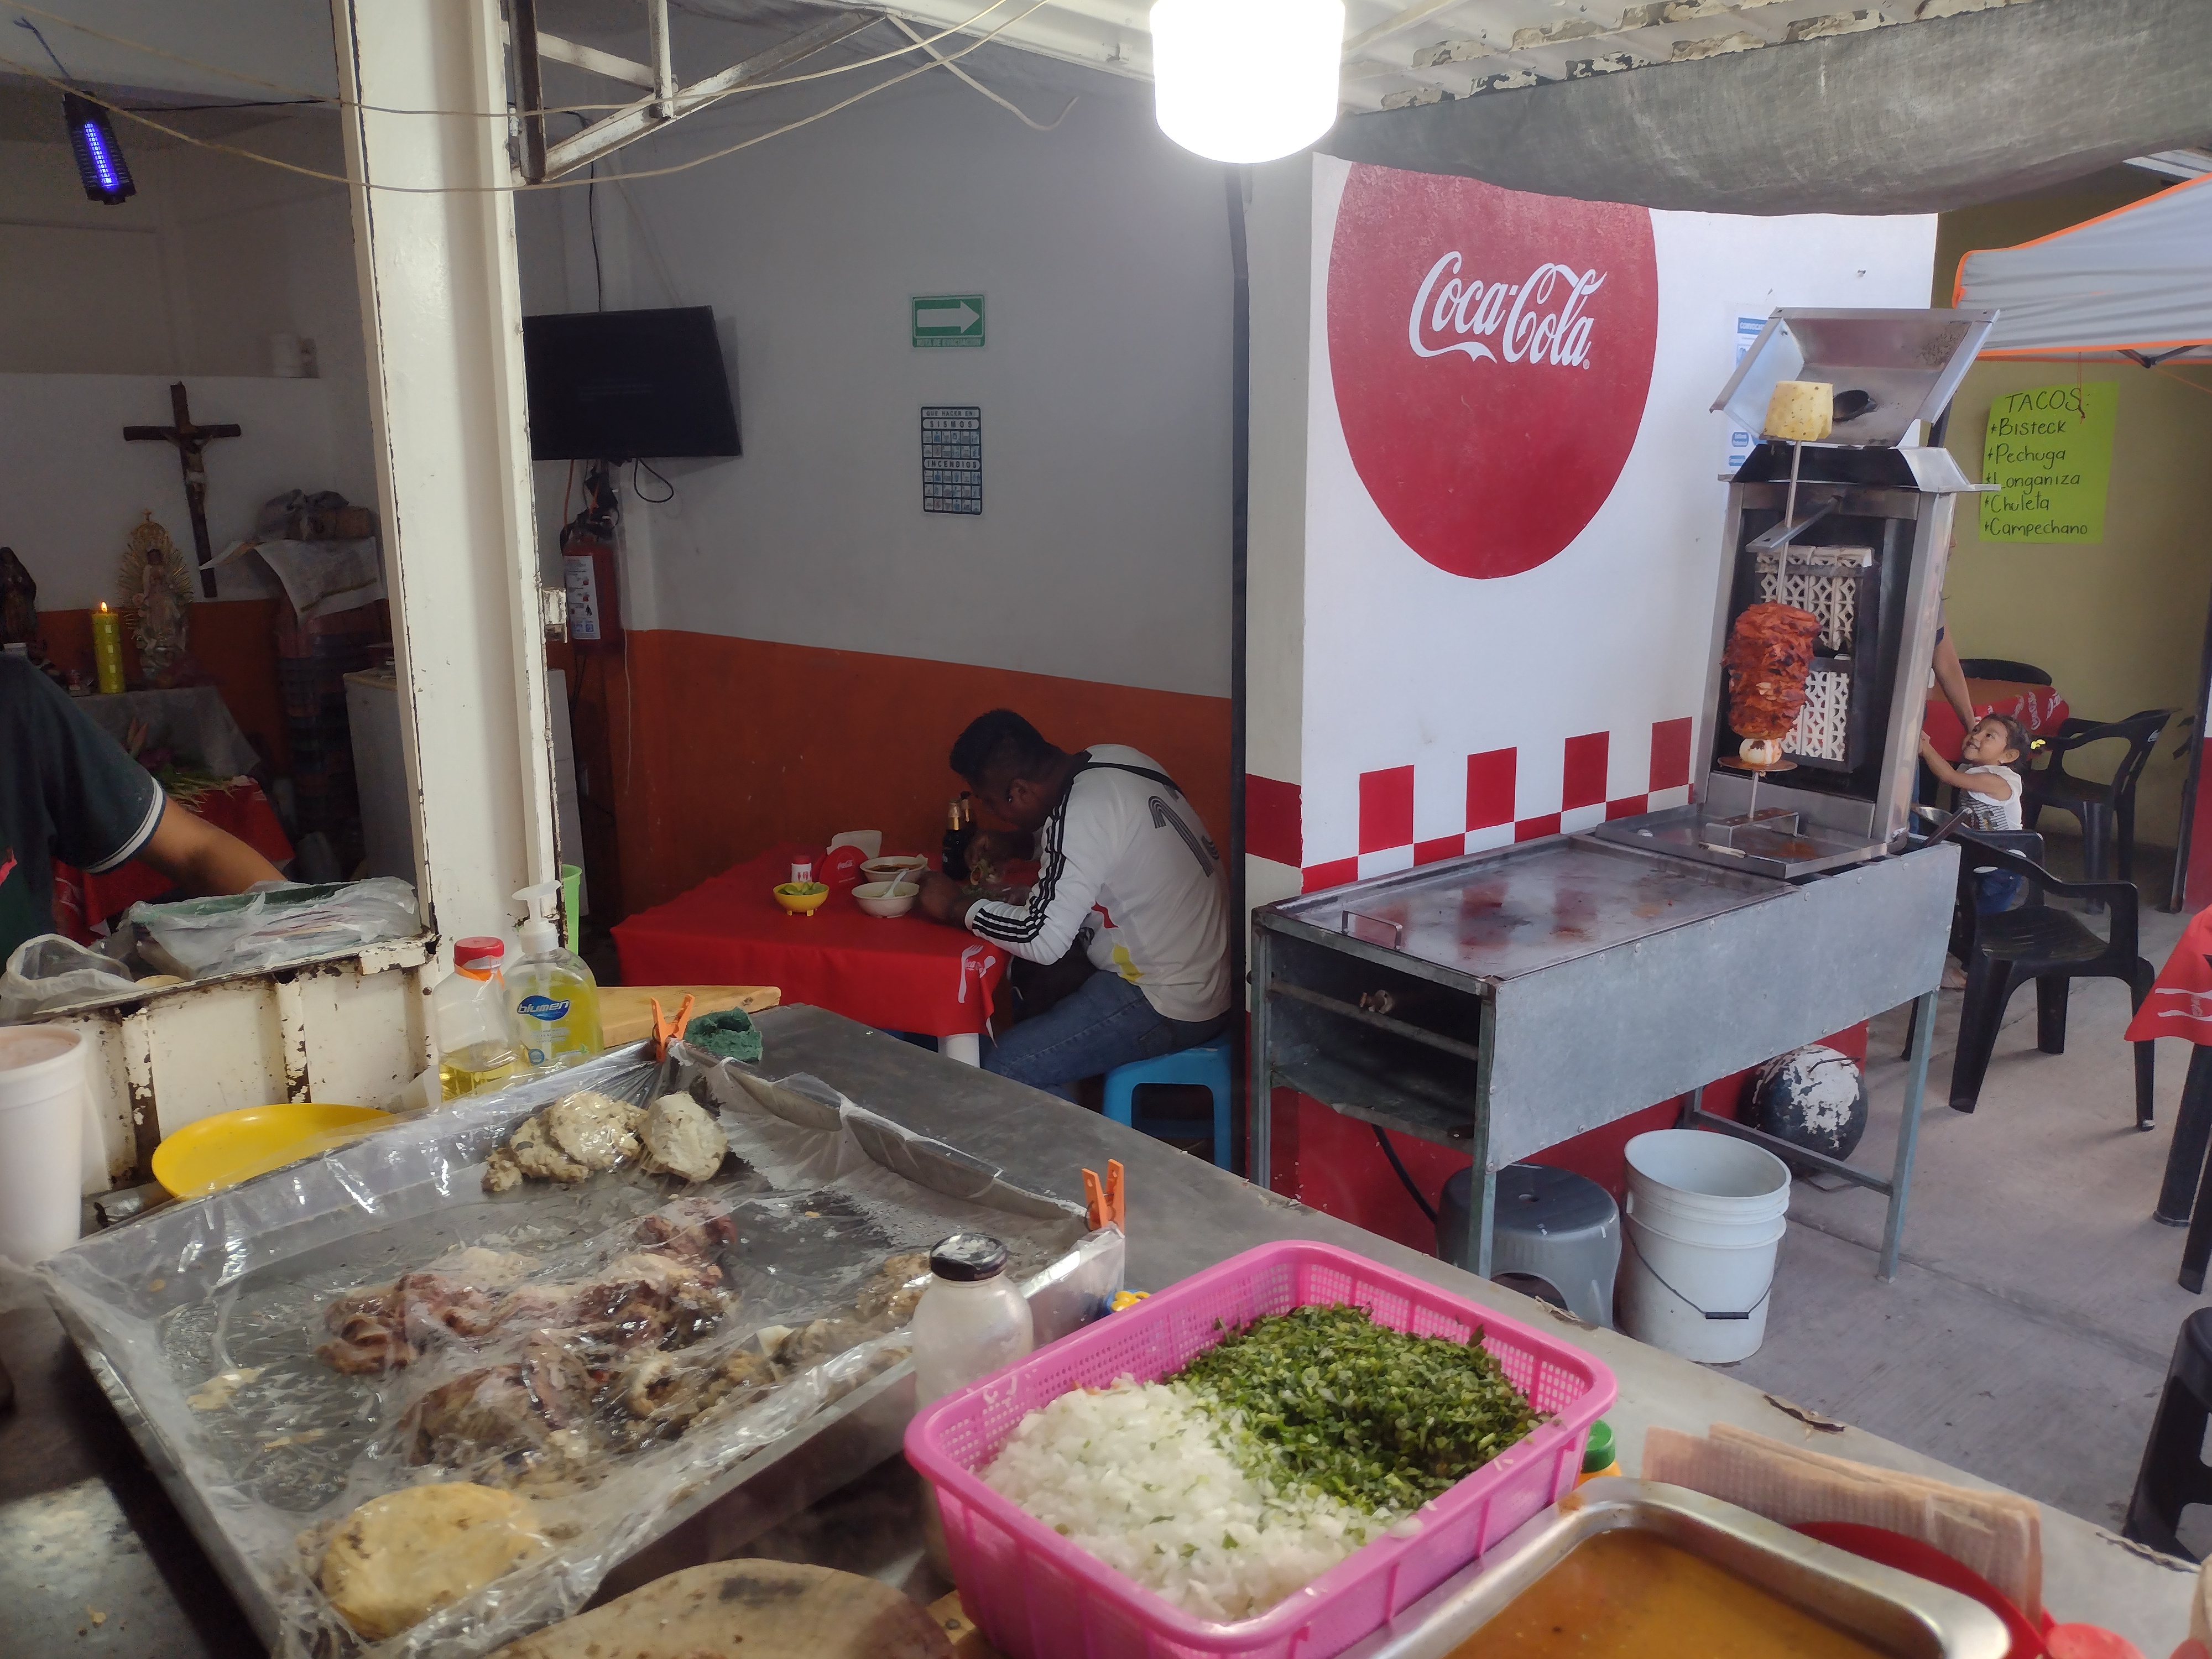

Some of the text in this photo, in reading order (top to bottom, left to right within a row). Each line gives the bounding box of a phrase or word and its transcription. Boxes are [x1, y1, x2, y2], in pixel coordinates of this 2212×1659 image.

[1408, 251, 1608, 367] Coca-Cola
[930, 420, 972, 428] SISMOS
[927, 460, 976, 468] INCENDIOS
[518, 1001, 569, 1013] blumen
